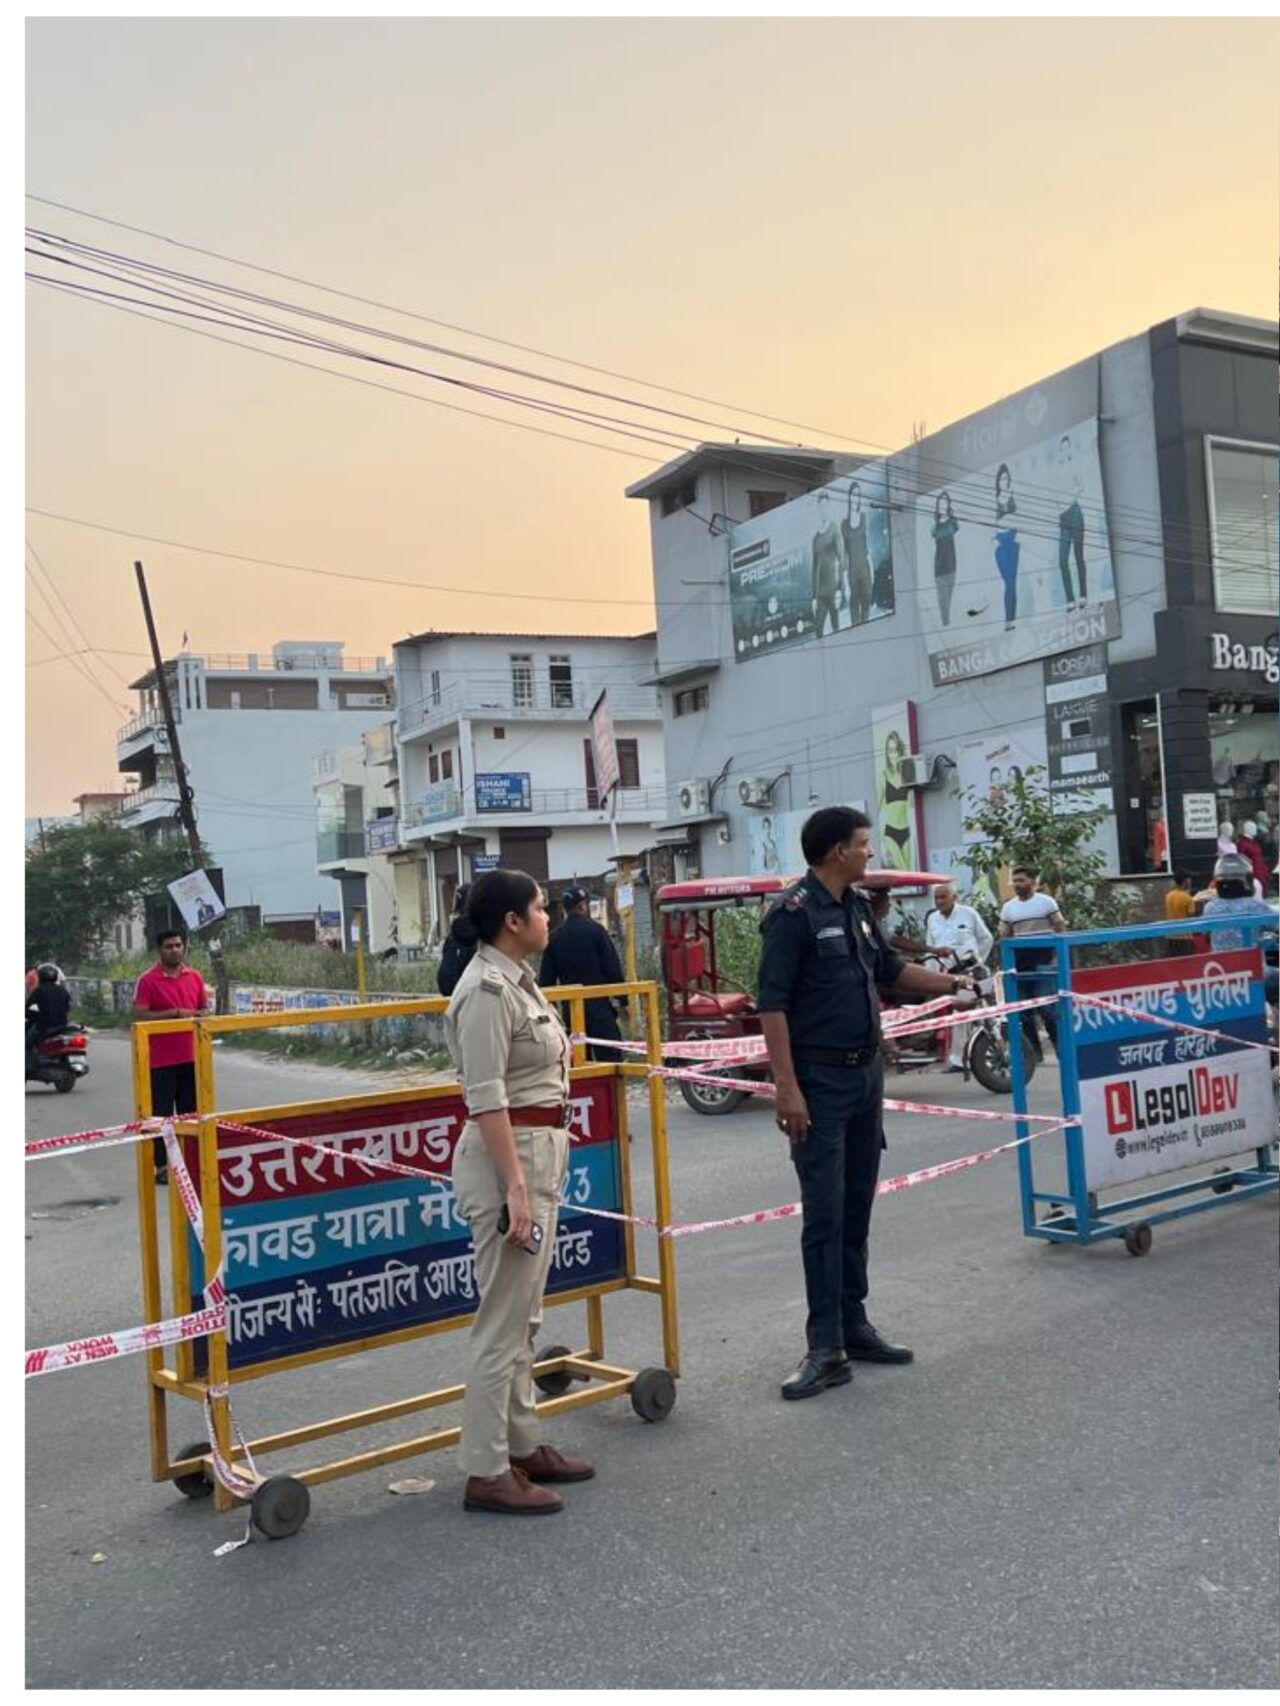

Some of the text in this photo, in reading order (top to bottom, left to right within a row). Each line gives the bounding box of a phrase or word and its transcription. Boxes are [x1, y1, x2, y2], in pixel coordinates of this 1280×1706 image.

[1050, 772, 1110, 788] mamaearth
[1182, 961, 1253, 1020] पुलिस
[1132, 1067, 1239, 1130] LegalDev
[324, 1197, 410, 1250] यात्रा
[327, 1263, 419, 1320] पंतजलि
